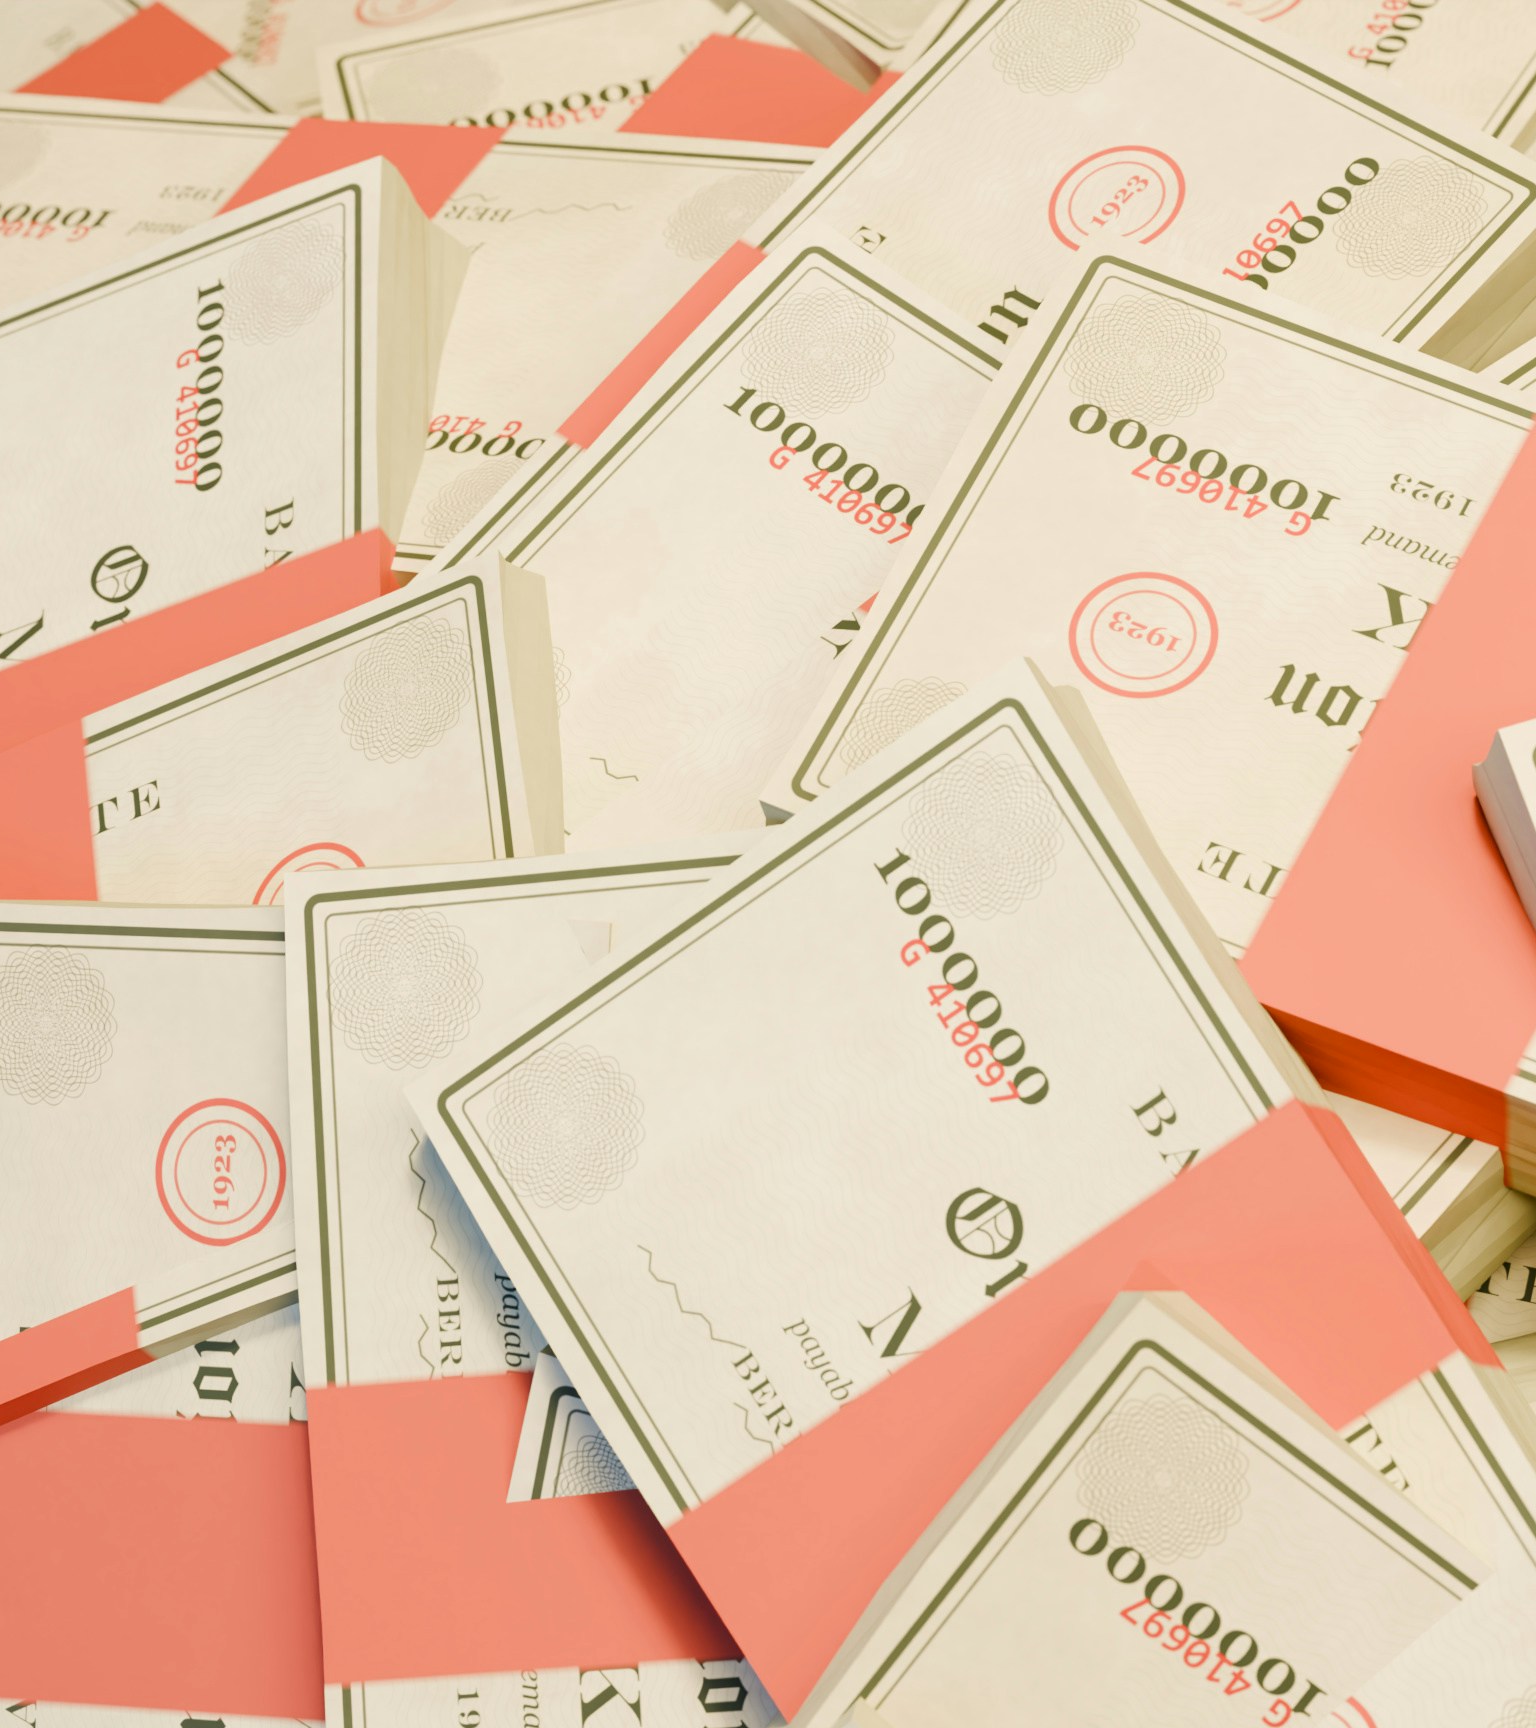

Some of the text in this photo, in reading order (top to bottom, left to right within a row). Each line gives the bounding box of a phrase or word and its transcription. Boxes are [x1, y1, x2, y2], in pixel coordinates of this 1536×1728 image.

[66, 222, 93, 242] G
[1090, 163, 1151, 227] 1923
[174, 347, 202, 487] G 410697
[194, 281, 226, 493] 1000000
[768, 443, 914, 546] G 410697
[1068, 402, 1342, 522] 1000000
[1130, 455, 1313, 538] G 410697
[1389, 472, 1474, 518] 1923
[1107, 609, 1180, 653] 1923
[873, 847, 1051, 1106] 1000000
[898, 937, 1022, 1104] G 410697
[212, 1133, 238, 1209] 1923
[781, 1317, 855, 1402] payab
[1068, 1516, 1327, 1718] 1000000
[1119, 1598, 1252, 1697] 410697
